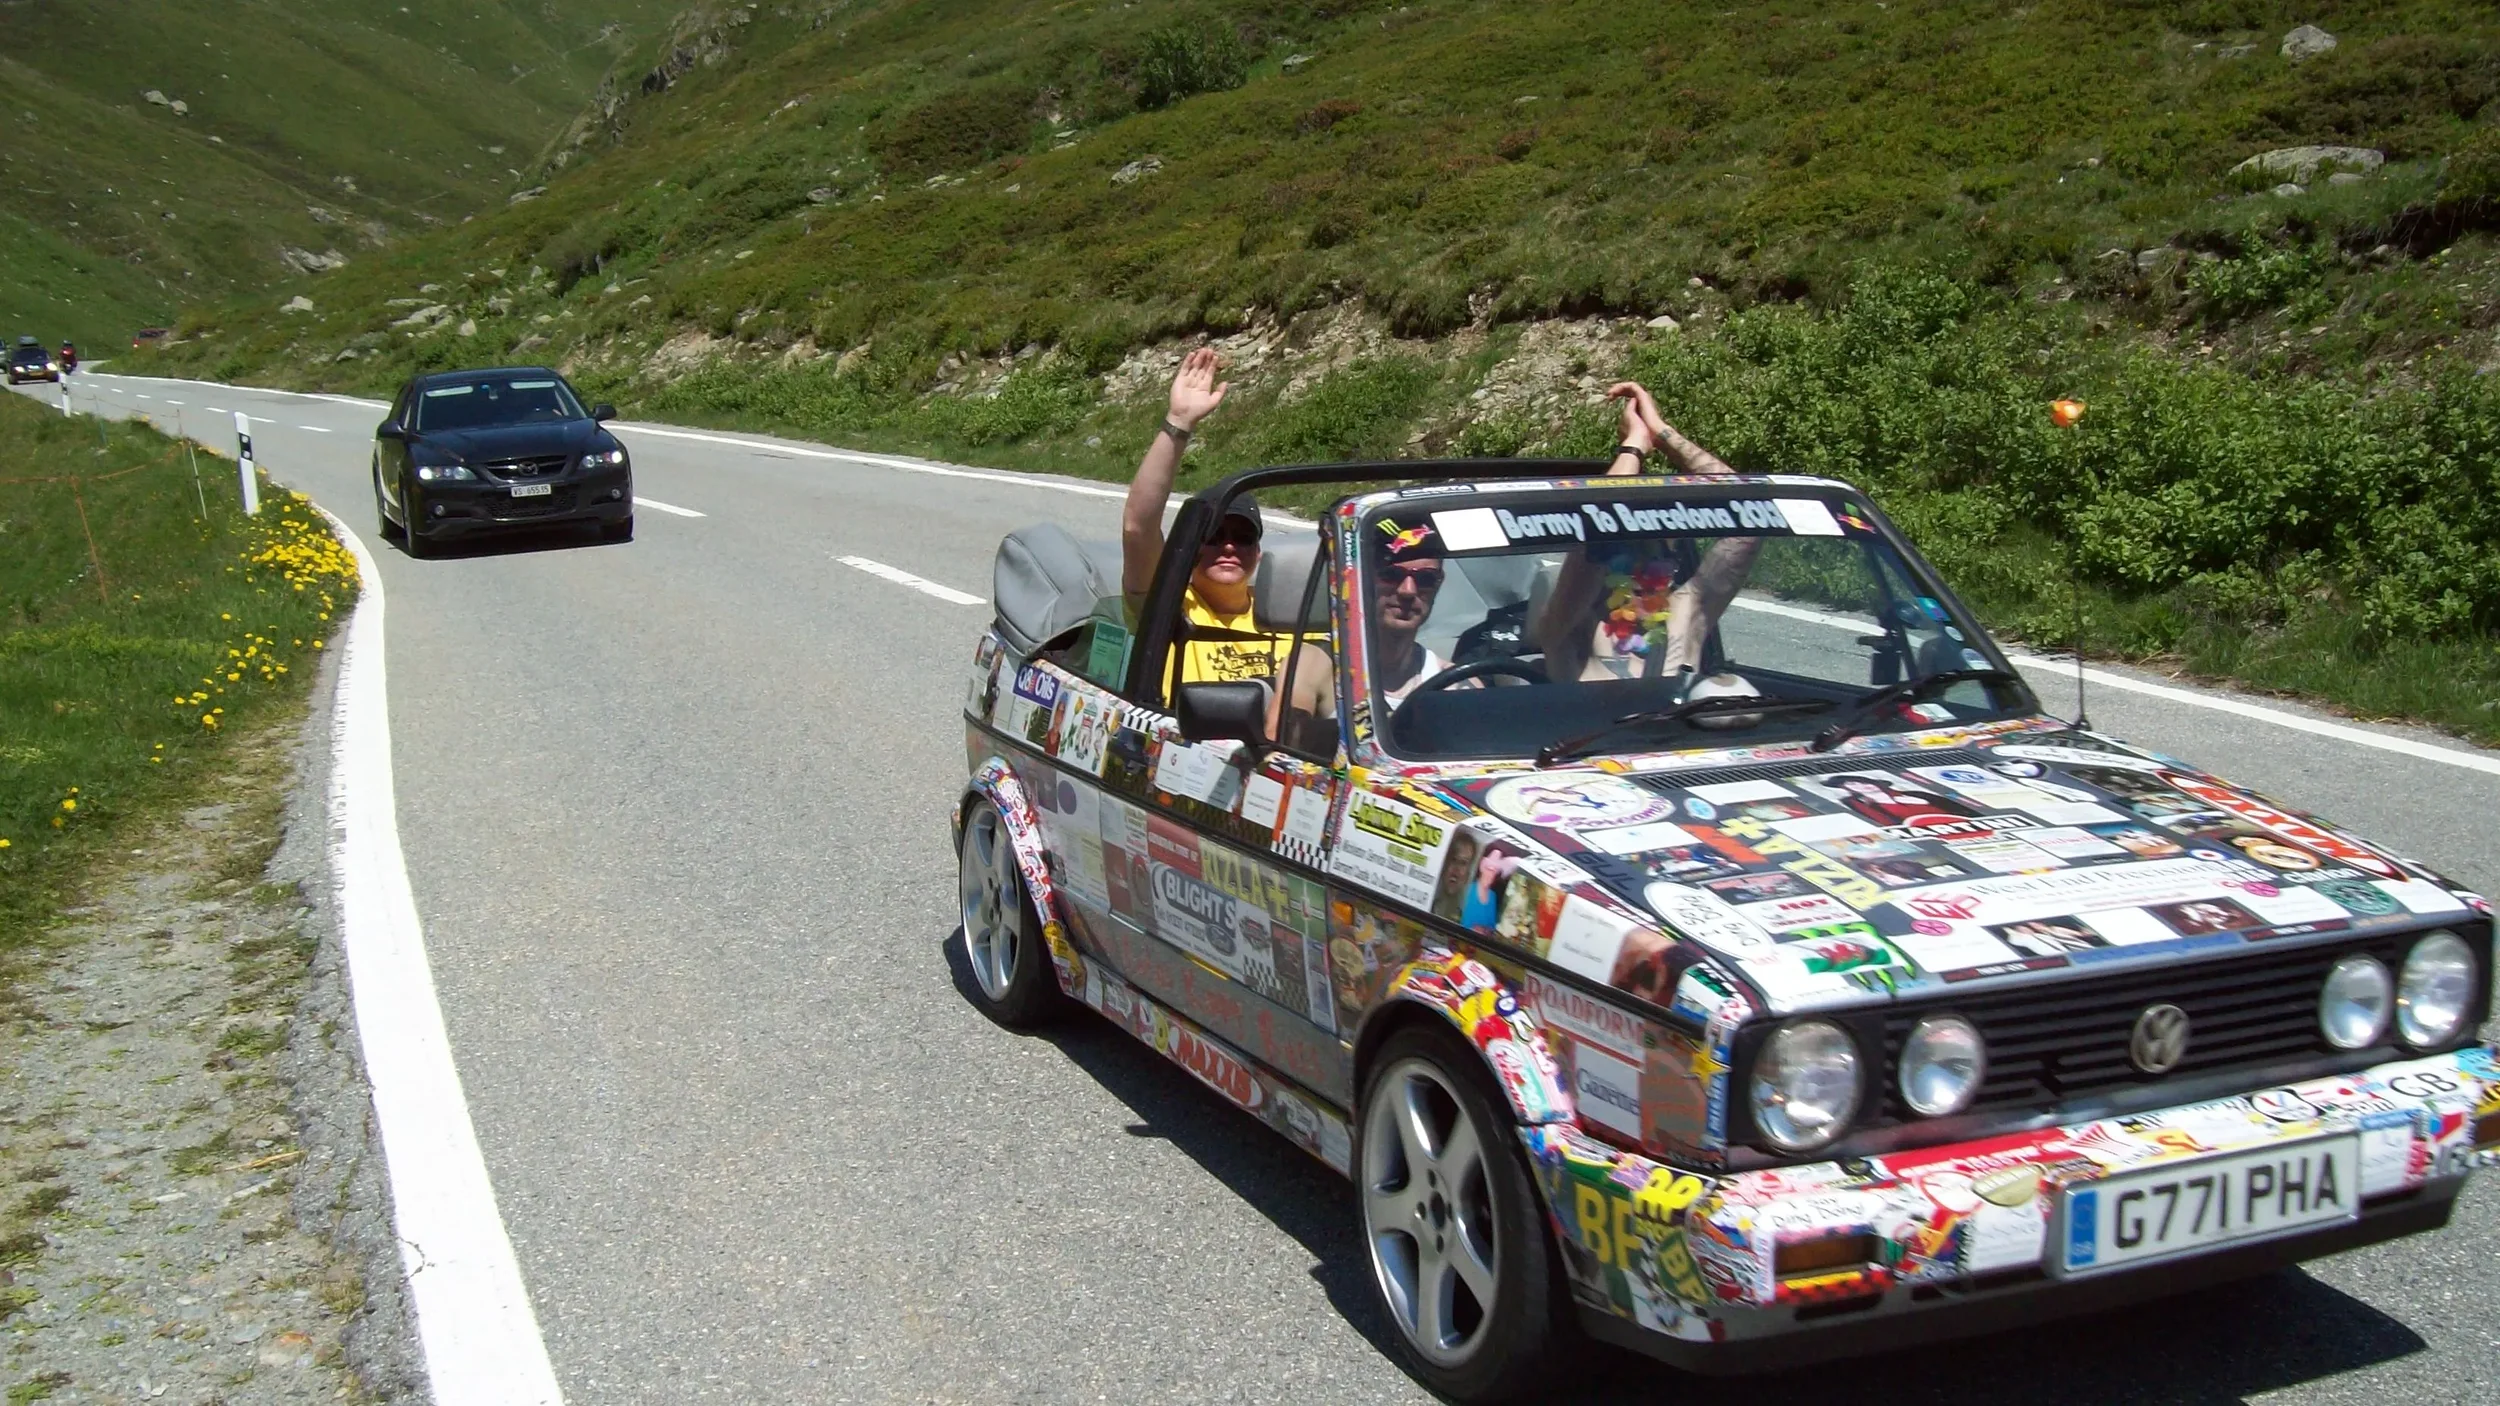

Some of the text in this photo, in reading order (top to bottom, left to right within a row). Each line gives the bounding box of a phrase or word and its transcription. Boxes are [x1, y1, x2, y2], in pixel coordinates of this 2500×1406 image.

[1586, 477, 1664, 487] MICHELIN
[1496, 508, 1586, 542] Barmy
[1581, 504, 1619, 533] To
[1612, 501, 1737, 532] Barcelona
[1035, 675, 1056, 702] Oils
[1967, 877, 2038, 897] West
[2039, 871, 2097, 891] End
[2098, 861, 2212, 885] Precision
[2389, 1072, 2459, 1098] GB
[2113, 1152, 2340, 1249] G771 PHA
